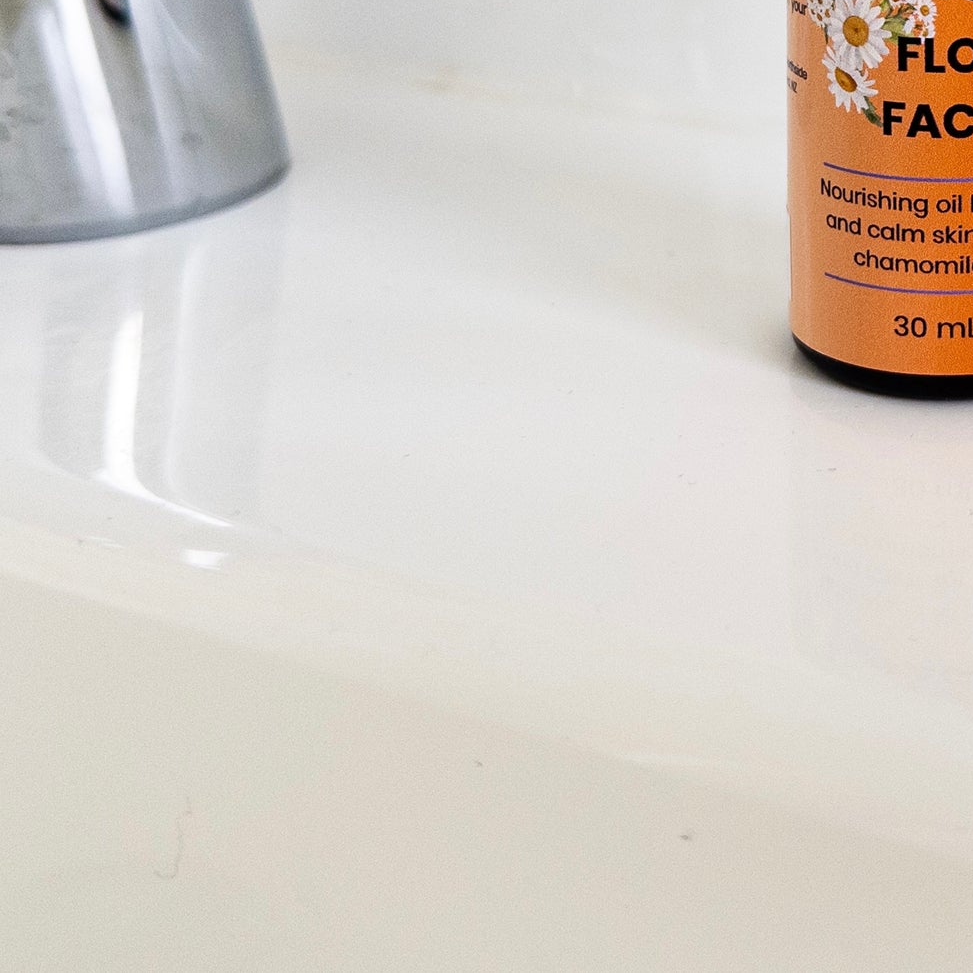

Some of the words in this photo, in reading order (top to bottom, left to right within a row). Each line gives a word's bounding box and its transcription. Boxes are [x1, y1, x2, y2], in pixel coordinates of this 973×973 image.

[791, 0, 809, 16] your
[820, 177, 929, 219] Nourishing
[935, 194, 963, 214] oil
[826, 213, 862, 236] and
[868, 223, 926, 243] calm
[893, 314, 928, 339] 30
